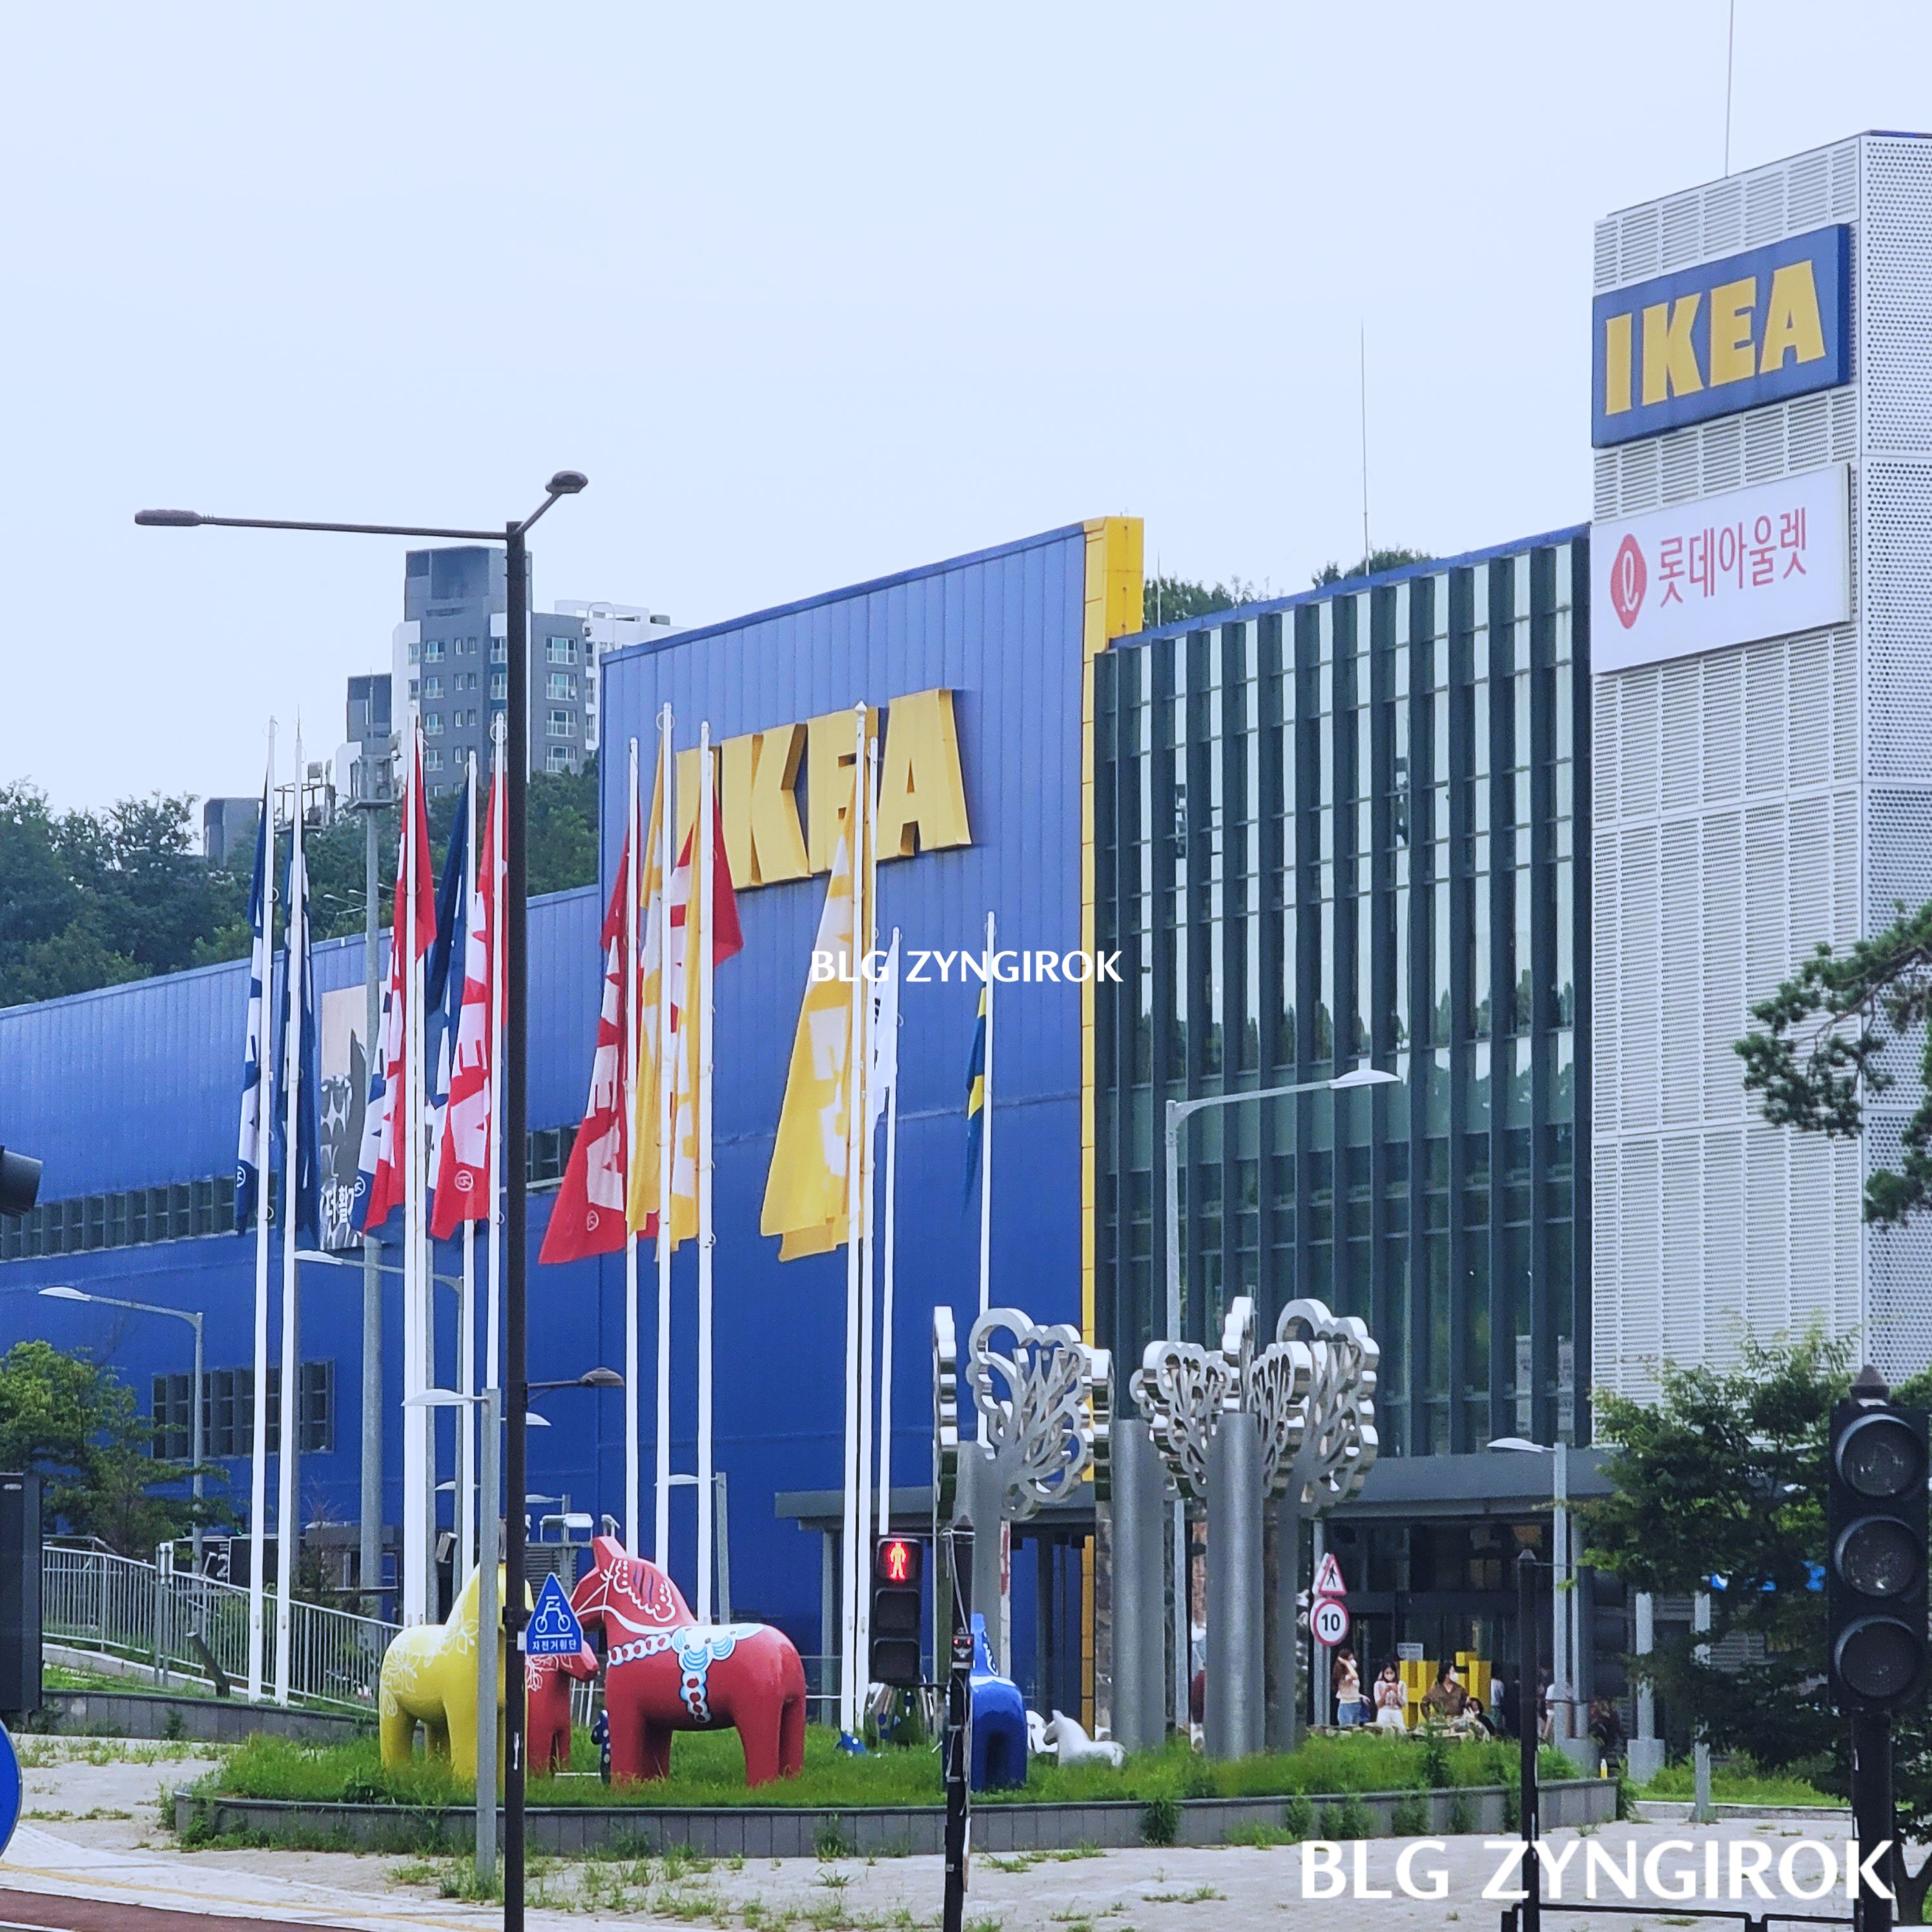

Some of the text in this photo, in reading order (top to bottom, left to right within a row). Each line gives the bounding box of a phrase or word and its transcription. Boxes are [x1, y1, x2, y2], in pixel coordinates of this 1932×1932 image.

[1605, 260, 1826, 416] IKEA
[1658, 507, 1807, 609] 롯데아울렛
[532, 1639, 577, 1652] 자전거횡단
[1321, 1613, 1341, 1632] 10
